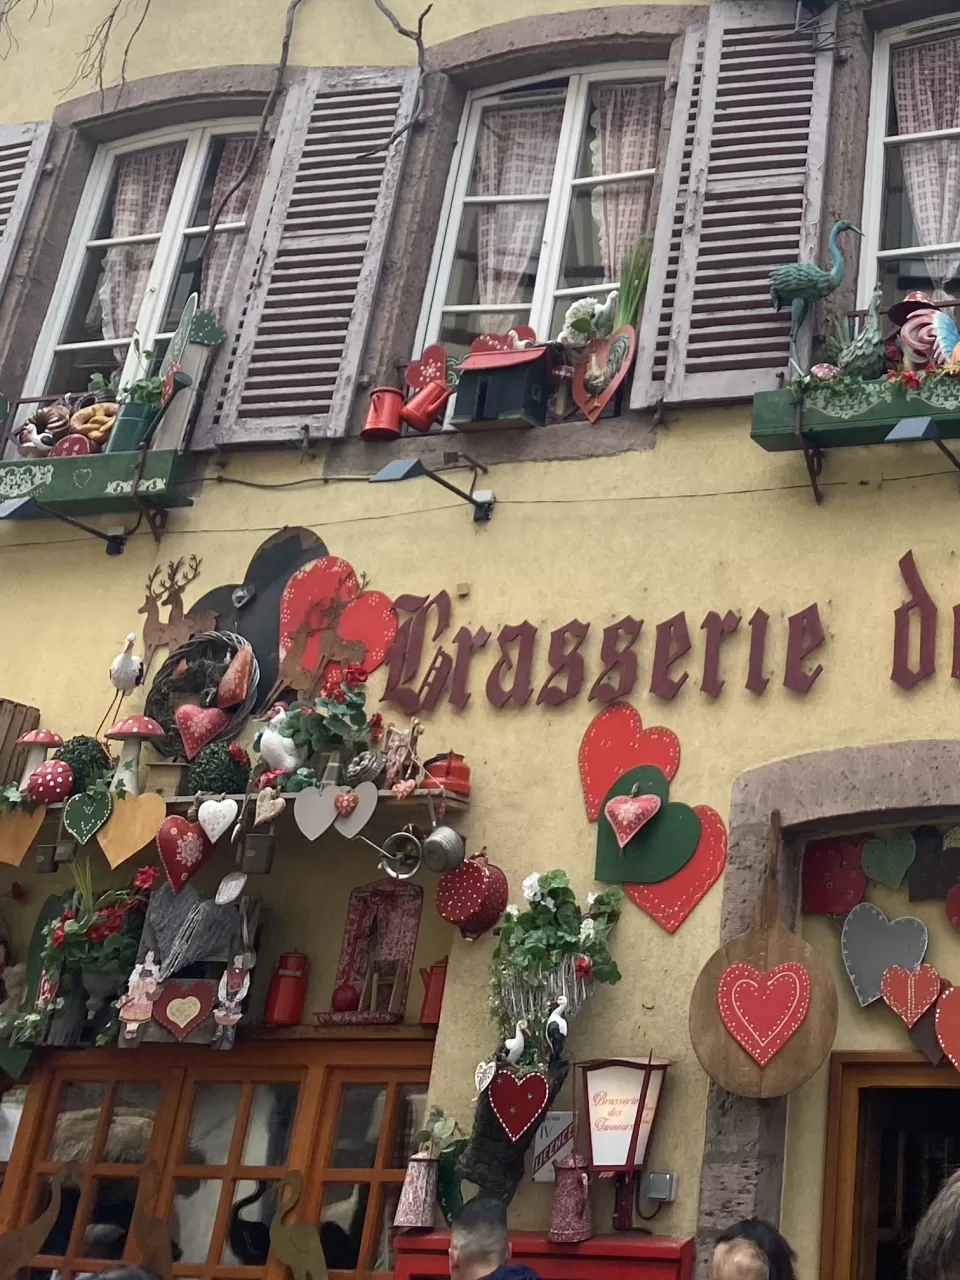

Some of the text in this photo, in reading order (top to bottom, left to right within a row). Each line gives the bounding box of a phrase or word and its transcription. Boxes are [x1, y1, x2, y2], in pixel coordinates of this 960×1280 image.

[378, 587, 827, 717] Brasserie
[592, 1091, 640, 1106] Brasserie
[607, 1107, 623, 1117] des
[594, 1117, 635, 1132] Tanneurs
[534, 1124, 574, 1171] LICENCE
